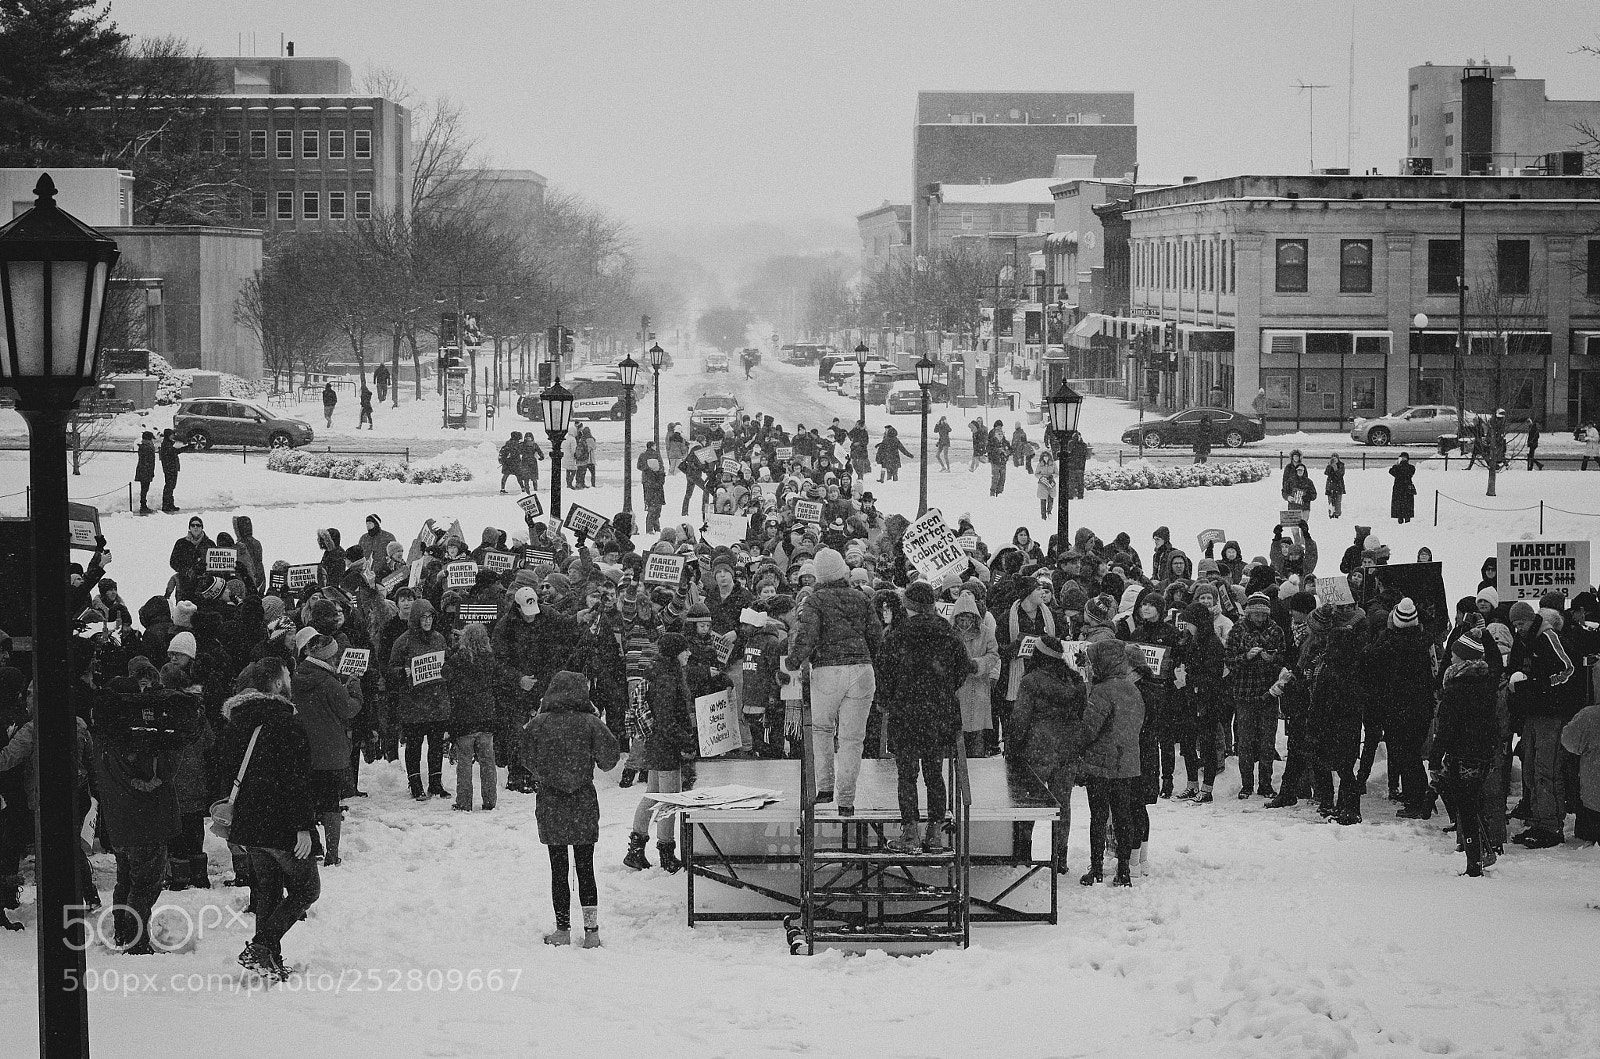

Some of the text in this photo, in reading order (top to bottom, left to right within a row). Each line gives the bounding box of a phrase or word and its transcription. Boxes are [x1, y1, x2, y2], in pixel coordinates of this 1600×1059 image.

[575, 516, 598, 530] FOR OUR
[577, 510, 598, 524] MARCH
[917, 515, 940, 533] seen
[913, 533, 954, 563] cabinets
[1510, 543, 1566, 557] MARCH
[650, 557, 676, 566] MARCH
[930, 545, 962, 571] IKEA
[1510, 557, 1576, 572] FOR OUR
[648, 571, 668, 579] LIVES
[665, 566, 680, 574] OUR
[1510, 572, 1553, 587] LIVES
[345, 651, 365, 659] MARCH
[414, 655, 437, 666] MARCH
[414, 662, 442, 674] FOR OUR
[415, 672, 433, 681] LIVES
